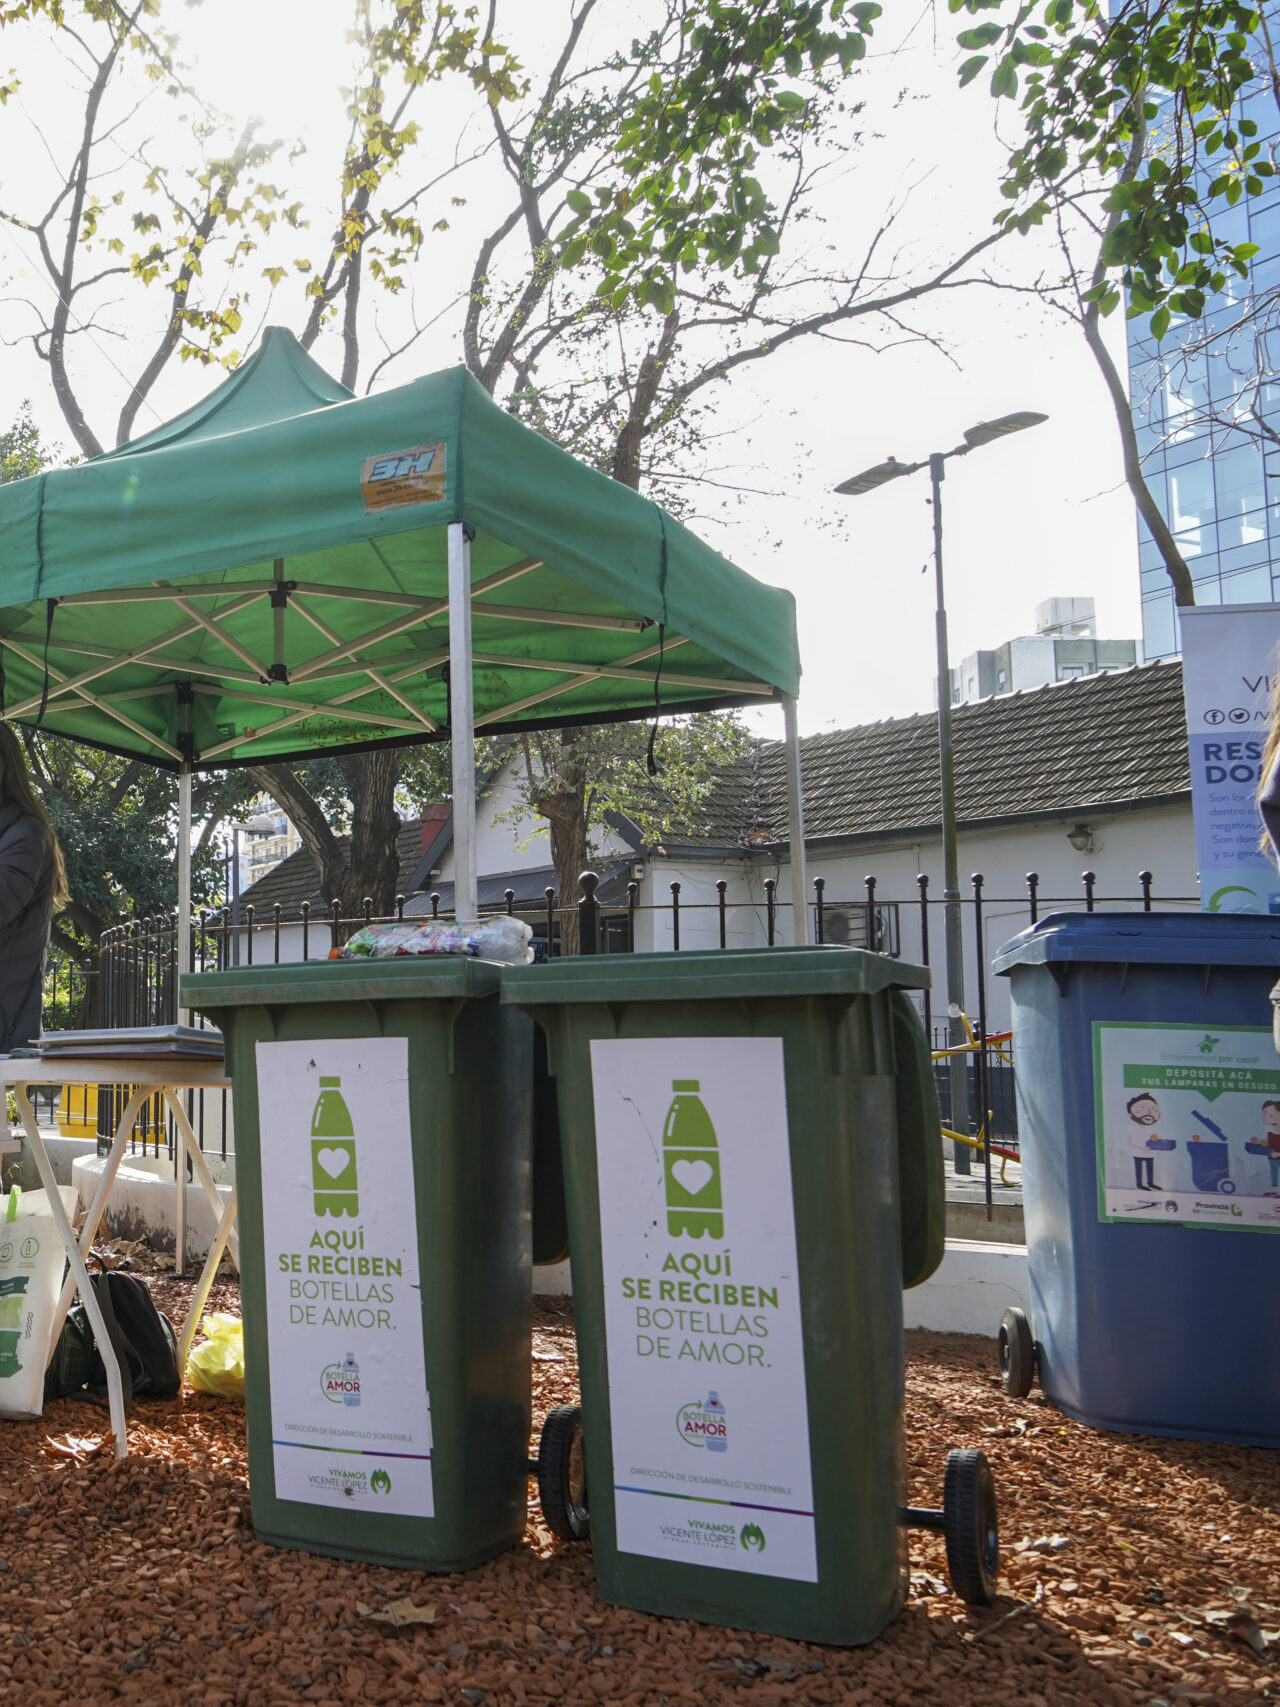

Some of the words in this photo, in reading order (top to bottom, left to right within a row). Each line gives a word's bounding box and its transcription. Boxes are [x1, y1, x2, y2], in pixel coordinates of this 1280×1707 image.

[368, 450, 436, 484] 3H
[1205, 764, 1262, 784] DO
[1141, 1077, 1161, 1086] TUS
[1164, 1077, 1218, 1088] LÁMPARAS
[1238, 1082, 1277, 1090] DESUSO
[1166, 1068, 1225, 1079] DEPOSITÁ
[1229, 1070, 1253, 1080] ACÁ
[1195, 1201, 1229, 1210] Provincia
[309, 1225, 364, 1254] AQUÍ
[278, 1253, 302, 1273] SE
[308, 1255, 402, 1278] RECIBEN
[662, 1249, 731, 1280] AQUÍ
[290, 1279, 394, 1303] BOTELLAS
[622, 1277, 652, 1300] SE
[659, 1279, 779, 1309] RECIBEN
[290, 1304, 317, 1325] DE
[322, 1307, 397, 1330] AMOR.
[636, 1306, 768, 1338] BOTELLAS
[636, 1334, 671, 1359] DE
[678, 1339, 772, 1368] AMOR.
[326, 1371, 360, 1381] BOTELLA
[327, 1380, 360, 1392] AMOR
[683, 1411, 726, 1424] BOTELLA
[284, 1423, 319, 1433] DIRECCIÓN
[329, 1428, 373, 1439] DESARROLLO
[373, 1432, 413, 1442] SOSTENIBLE
[684, 1421, 727, 1437] AMOR
[308, 1475, 340, 1487] VICENTE
[342, 1478, 367, 1490] LÓPEZ
[329, 1468, 367, 1480] VIVAMOS
[630, 1467, 675, 1480] DIRECCIÓN
[676, 1473, 687, 1482] DE
[688, 1475, 742, 1489] DESARROLLO
[743, 1482, 792, 1496] SOSTENIBLE
[660, 1525, 702, 1541] VICENTE
[703, 1532, 736, 1546] LÓPEZ
[687, 1519, 736, 1534] VIVAMOS
